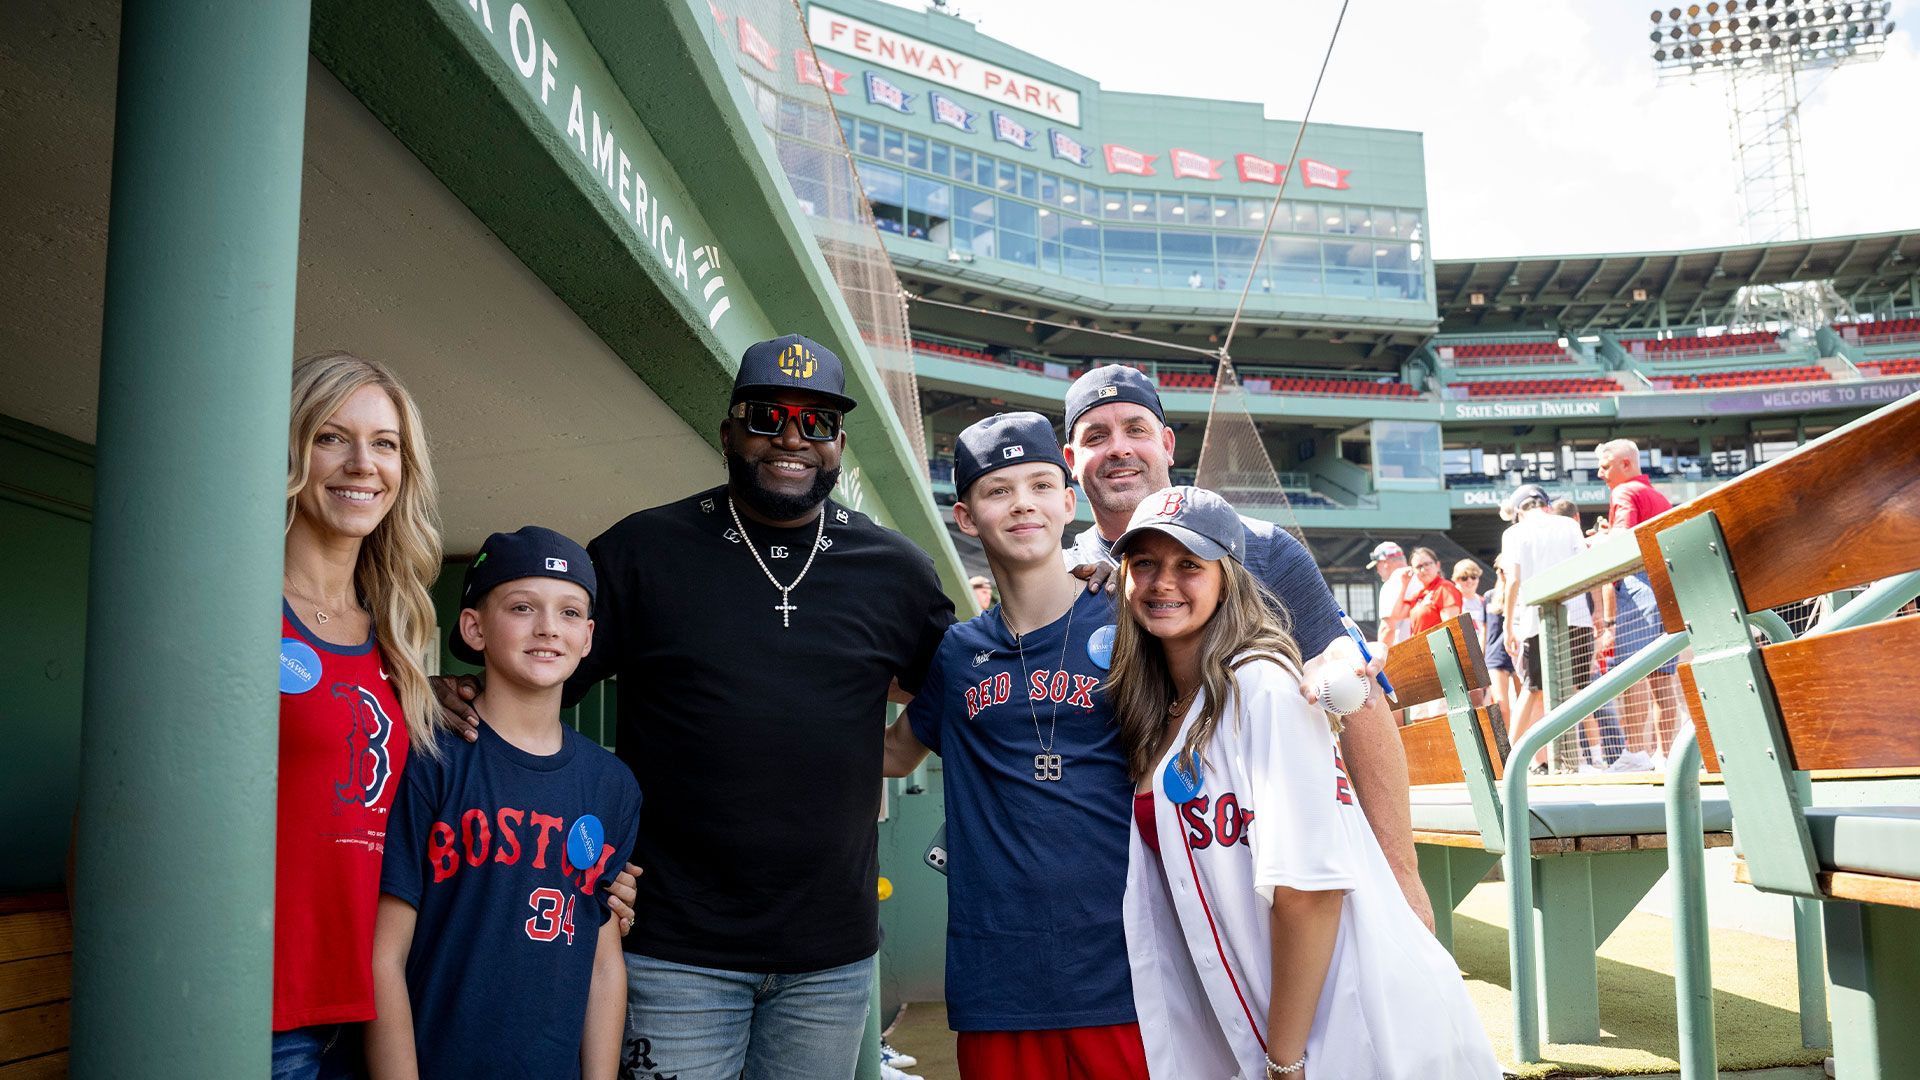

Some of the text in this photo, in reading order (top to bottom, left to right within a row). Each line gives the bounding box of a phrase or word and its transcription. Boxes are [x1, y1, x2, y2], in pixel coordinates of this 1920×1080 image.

[831, 21, 963, 79] FENWAY
[984, 71, 1062, 113] PARK
[509, 3, 688, 290] OF AMERICA
[1456, 401, 1600, 418] STATE STREET PAVILION
[1762, 390, 1833, 407] WELCOME
[1836, 387, 1856, 401] TO
[1157, 491, 1183, 517] B
[1575, 488, 1605, 500] Level
[771, 546, 789, 559] DG
[965, 669, 1100, 720] RED SOX
[331, 682, 394, 808] B
[1034, 754, 1062, 781] 99
[525, 887, 576, 946] 34
